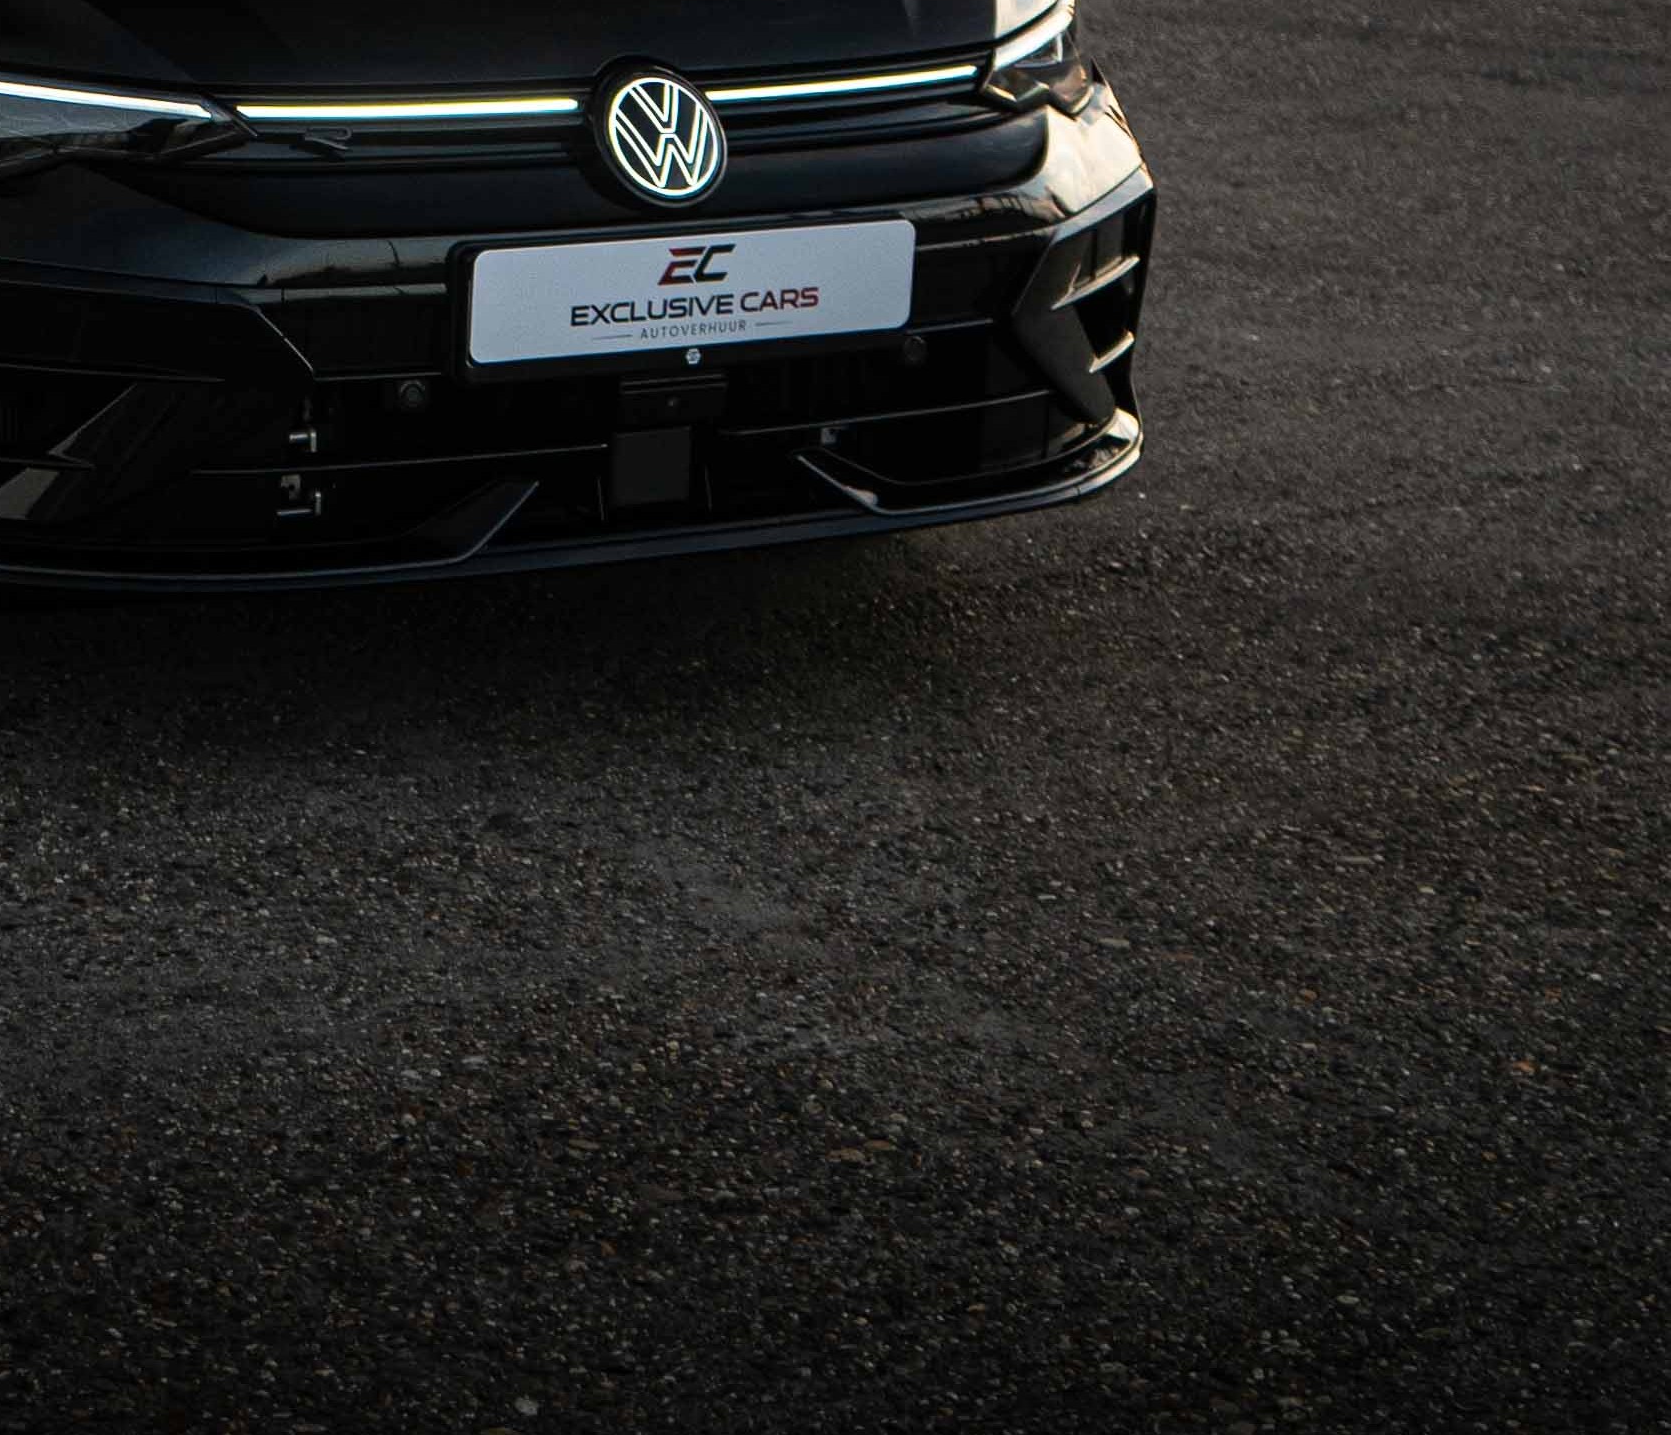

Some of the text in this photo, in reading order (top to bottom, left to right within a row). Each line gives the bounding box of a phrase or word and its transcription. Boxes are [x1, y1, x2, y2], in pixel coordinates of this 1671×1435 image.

[610, 78, 716, 192] VW
[657, 243, 737, 286] EC
[570, 286, 819, 327] EXCLUSIVE CARS
[640, 320, 746, 340] AUTOVERHUUR
